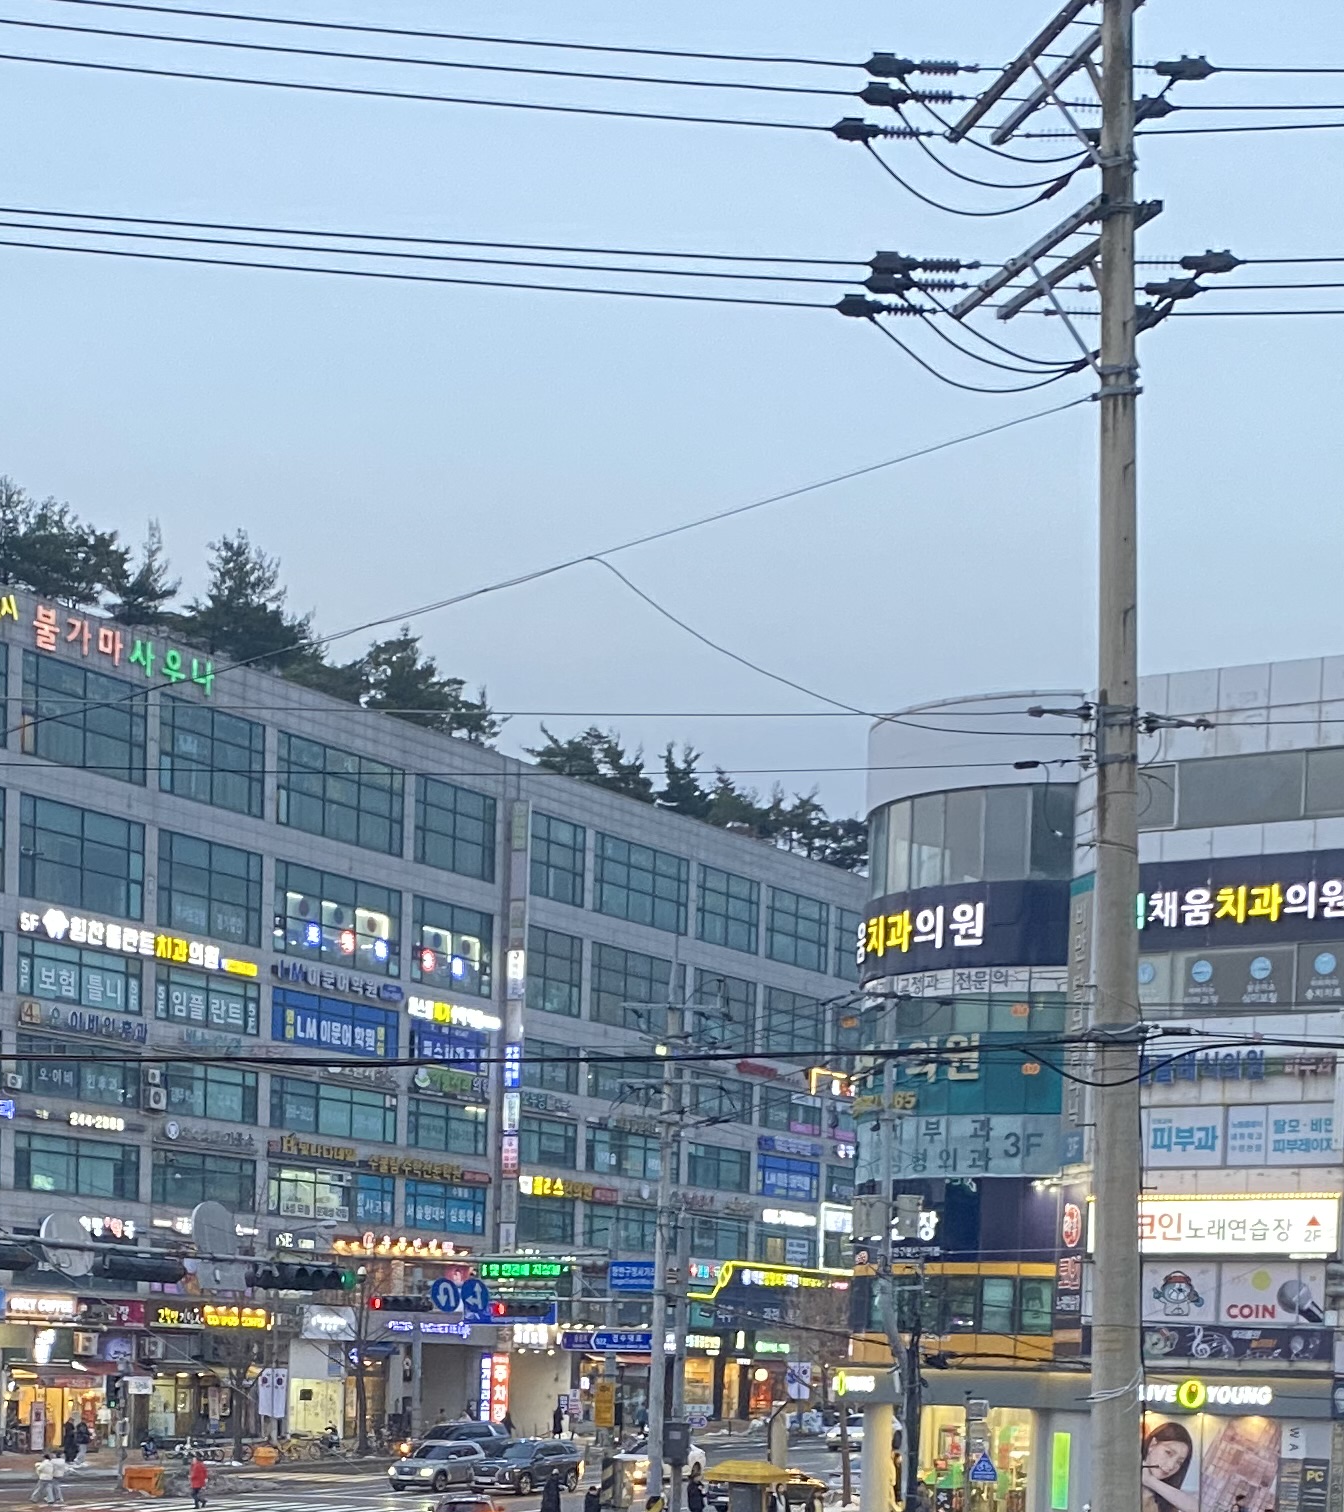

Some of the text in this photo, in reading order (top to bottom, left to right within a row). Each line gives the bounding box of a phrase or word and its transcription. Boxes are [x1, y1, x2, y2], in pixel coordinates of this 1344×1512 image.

[33, 604, 124, 667] 불가마
[129, 639, 216, 696] 사우나
[23, 911, 40, 932] 5F
[39, 966, 76, 998] 보험
[87, 973, 123, 1006] 틀니
[172, 991, 244, 1027] 임플란트
[67, 1012, 149, 1045] 이비인후과
[1004, 1131, 1044, 1158] 3F
[1151, 1125, 1218, 1152] 피부과
[1303, 1229, 1322, 1243] 2F
[1226, 1303, 1276, 1320] COIN
[1206, 1386, 1273, 1405] YOUNG
